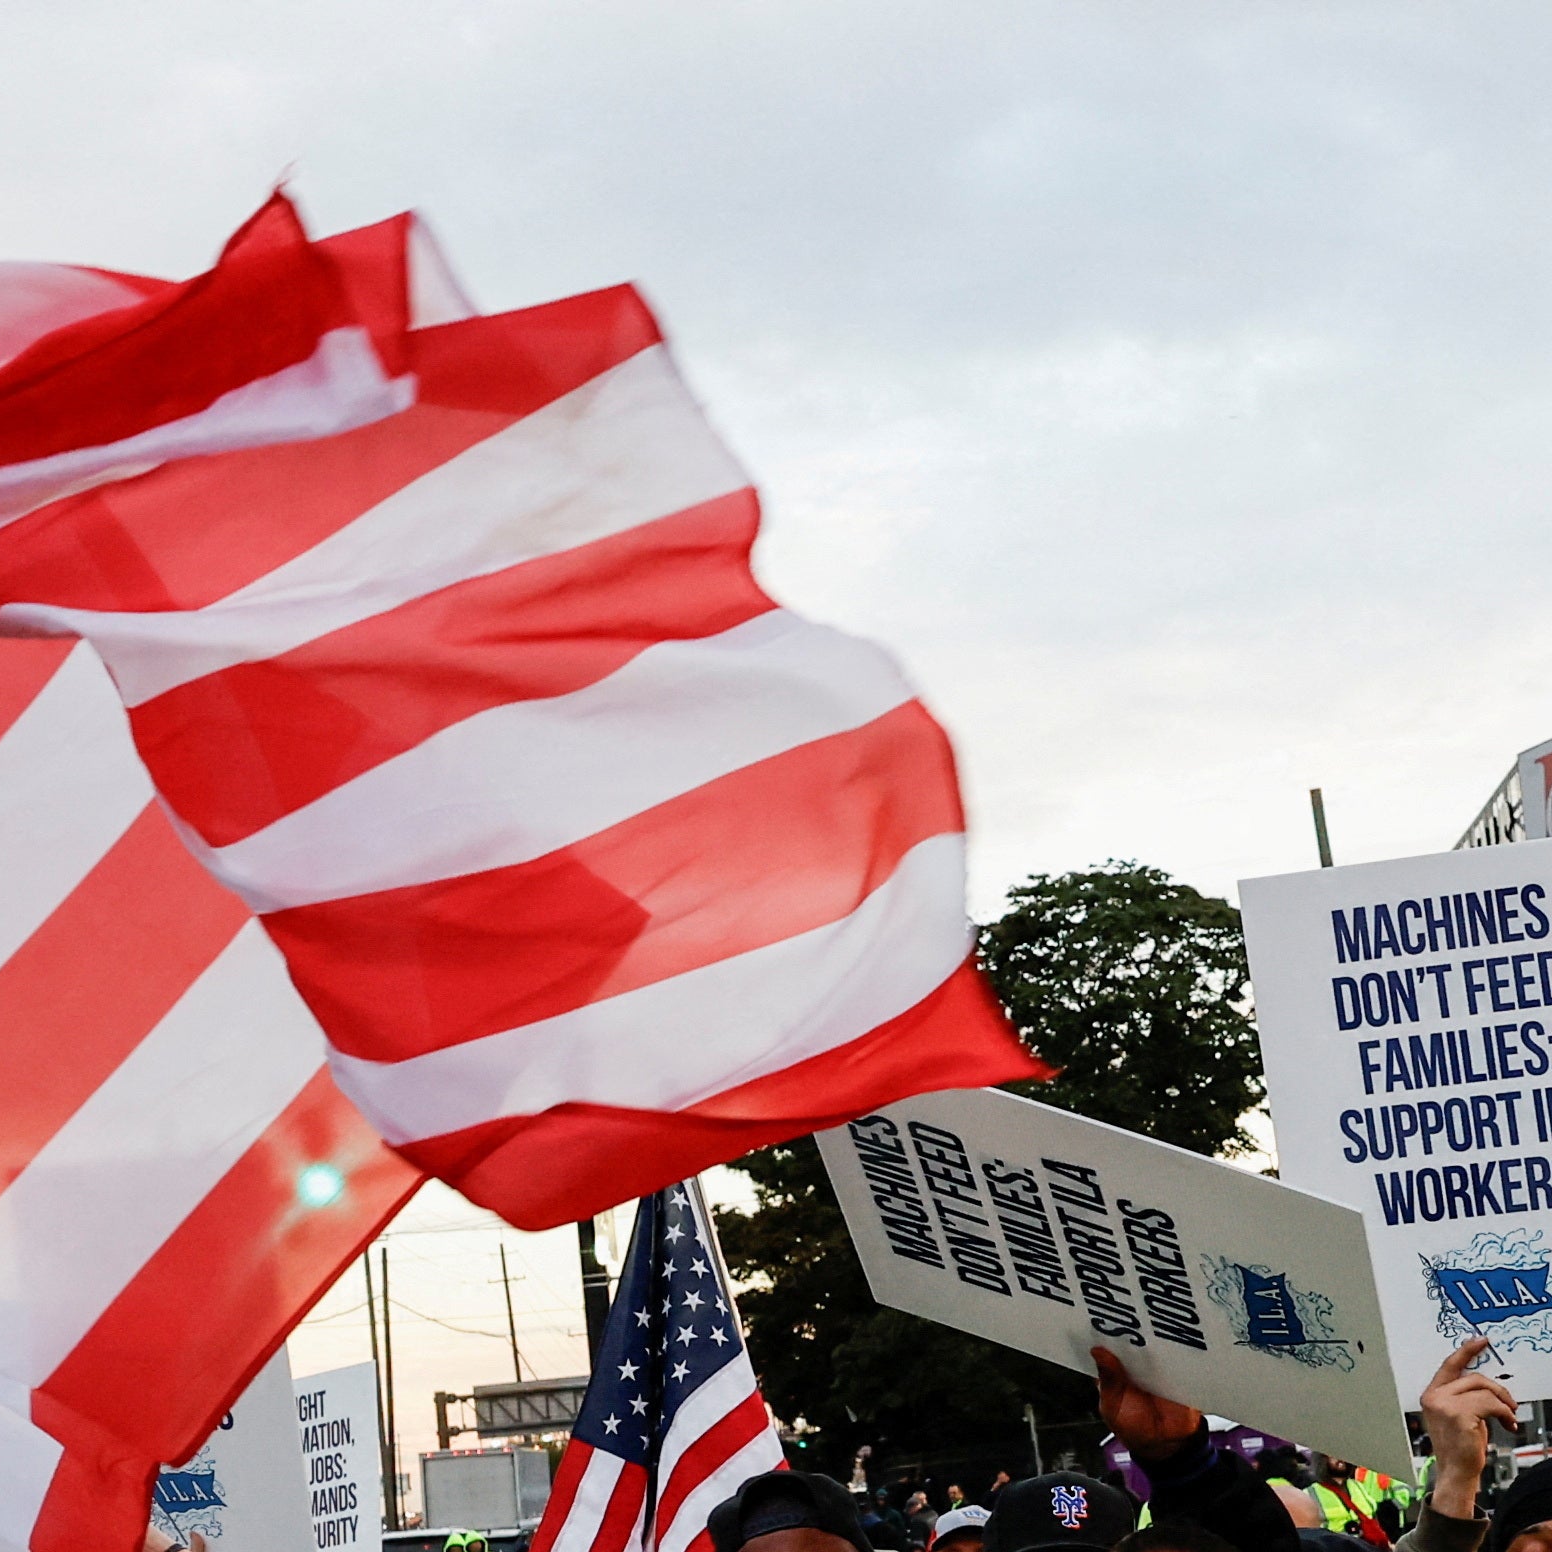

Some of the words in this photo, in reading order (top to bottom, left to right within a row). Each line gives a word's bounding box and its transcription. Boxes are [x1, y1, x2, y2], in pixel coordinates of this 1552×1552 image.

[1332, 884, 1549, 963] MACHINES
[1332, 964, 1452, 1031] DON'T
[907, 1121, 984, 1206] FEED
[1340, 1091, 1521, 1163] SUPPORT
[851, 1115, 945, 1269] MACHINES
[1041, 1157, 1108, 1215] ILA
[932, 1198, 1012, 1297] DON'T
[981, 1158, 1075, 1306] FAMILIES:
[1055, 1206, 1146, 1347] SUPPORT
[1116, 1199, 1207, 1350] WORKERS
[298, 1391, 325, 1421] GHT
[300, 1417, 355, 1453] MATION,
[309, 1453, 347, 1485] JOBS:
[314, 1515, 359, 1549] URITY
